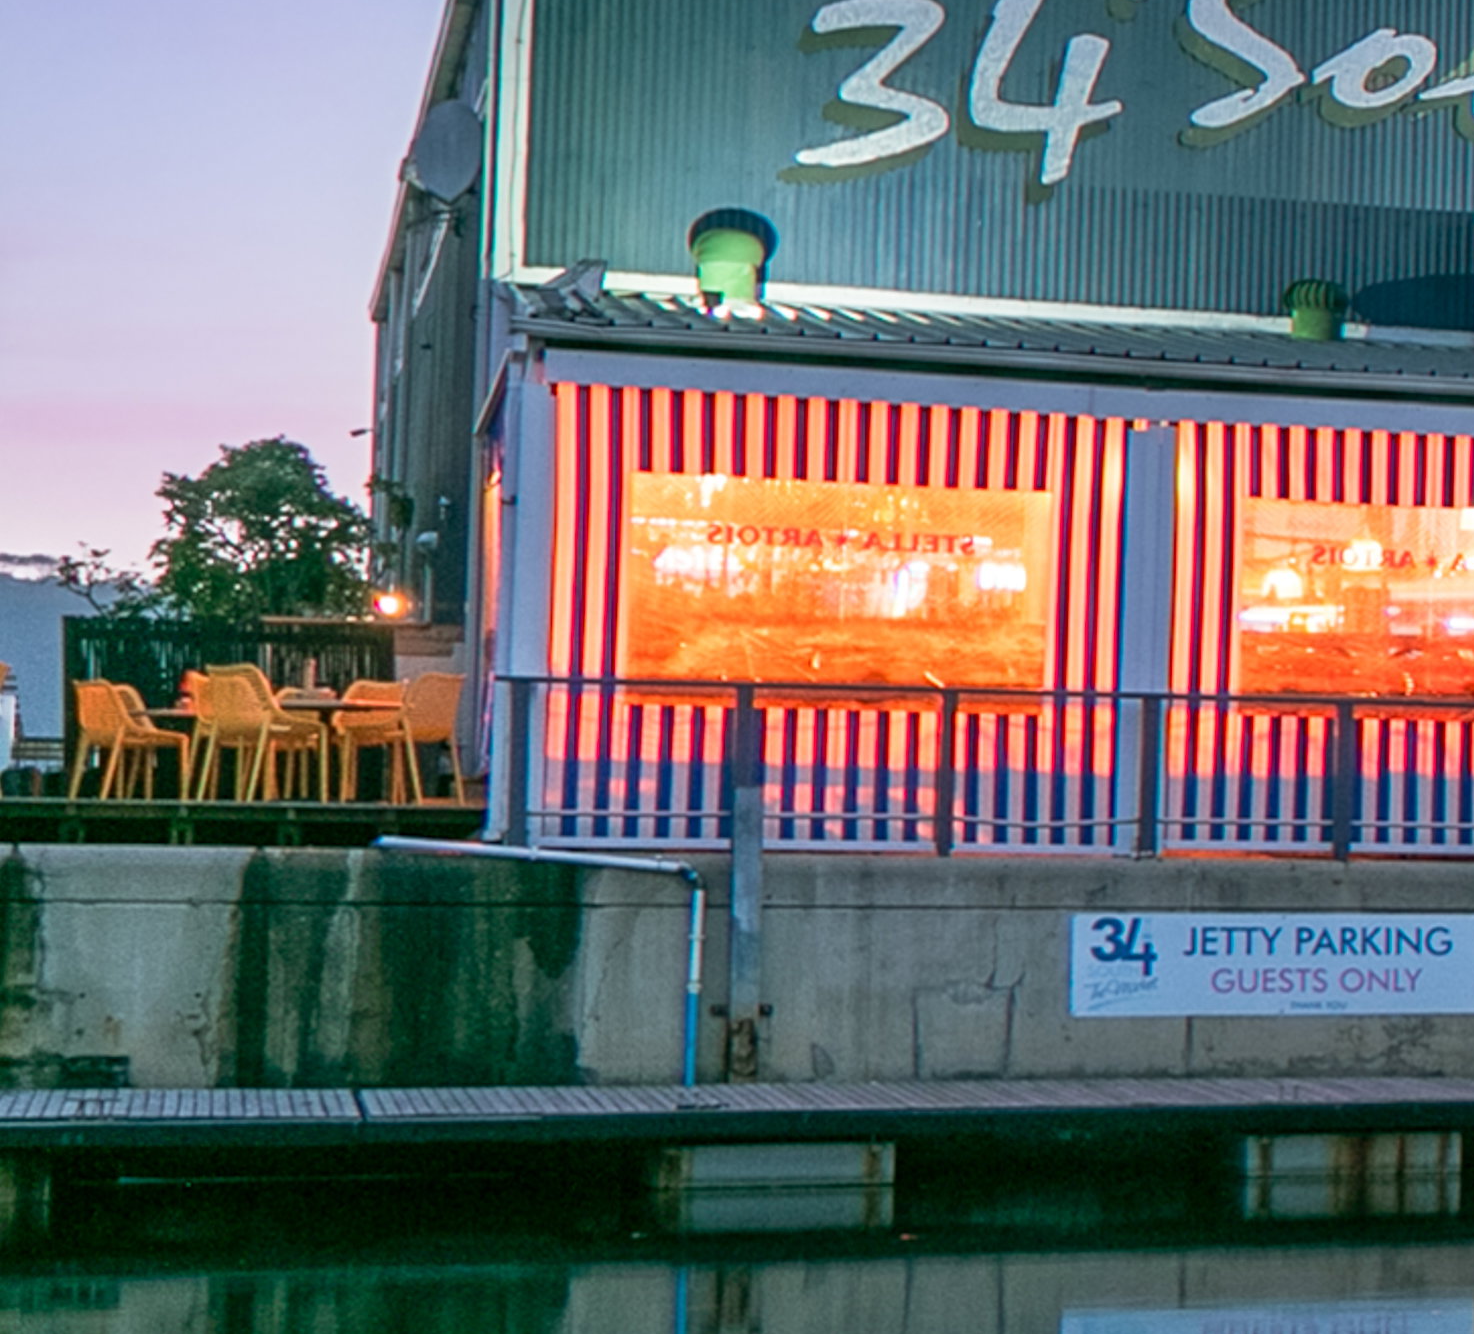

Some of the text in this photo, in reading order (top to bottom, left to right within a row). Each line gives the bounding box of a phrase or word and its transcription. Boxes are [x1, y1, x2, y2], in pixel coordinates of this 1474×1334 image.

[1090, 916, 1158, 976] 34
[1183, 927, 1454, 956] JETTY PARKING
[1210, 968, 1422, 994] GUESTS ONLY
